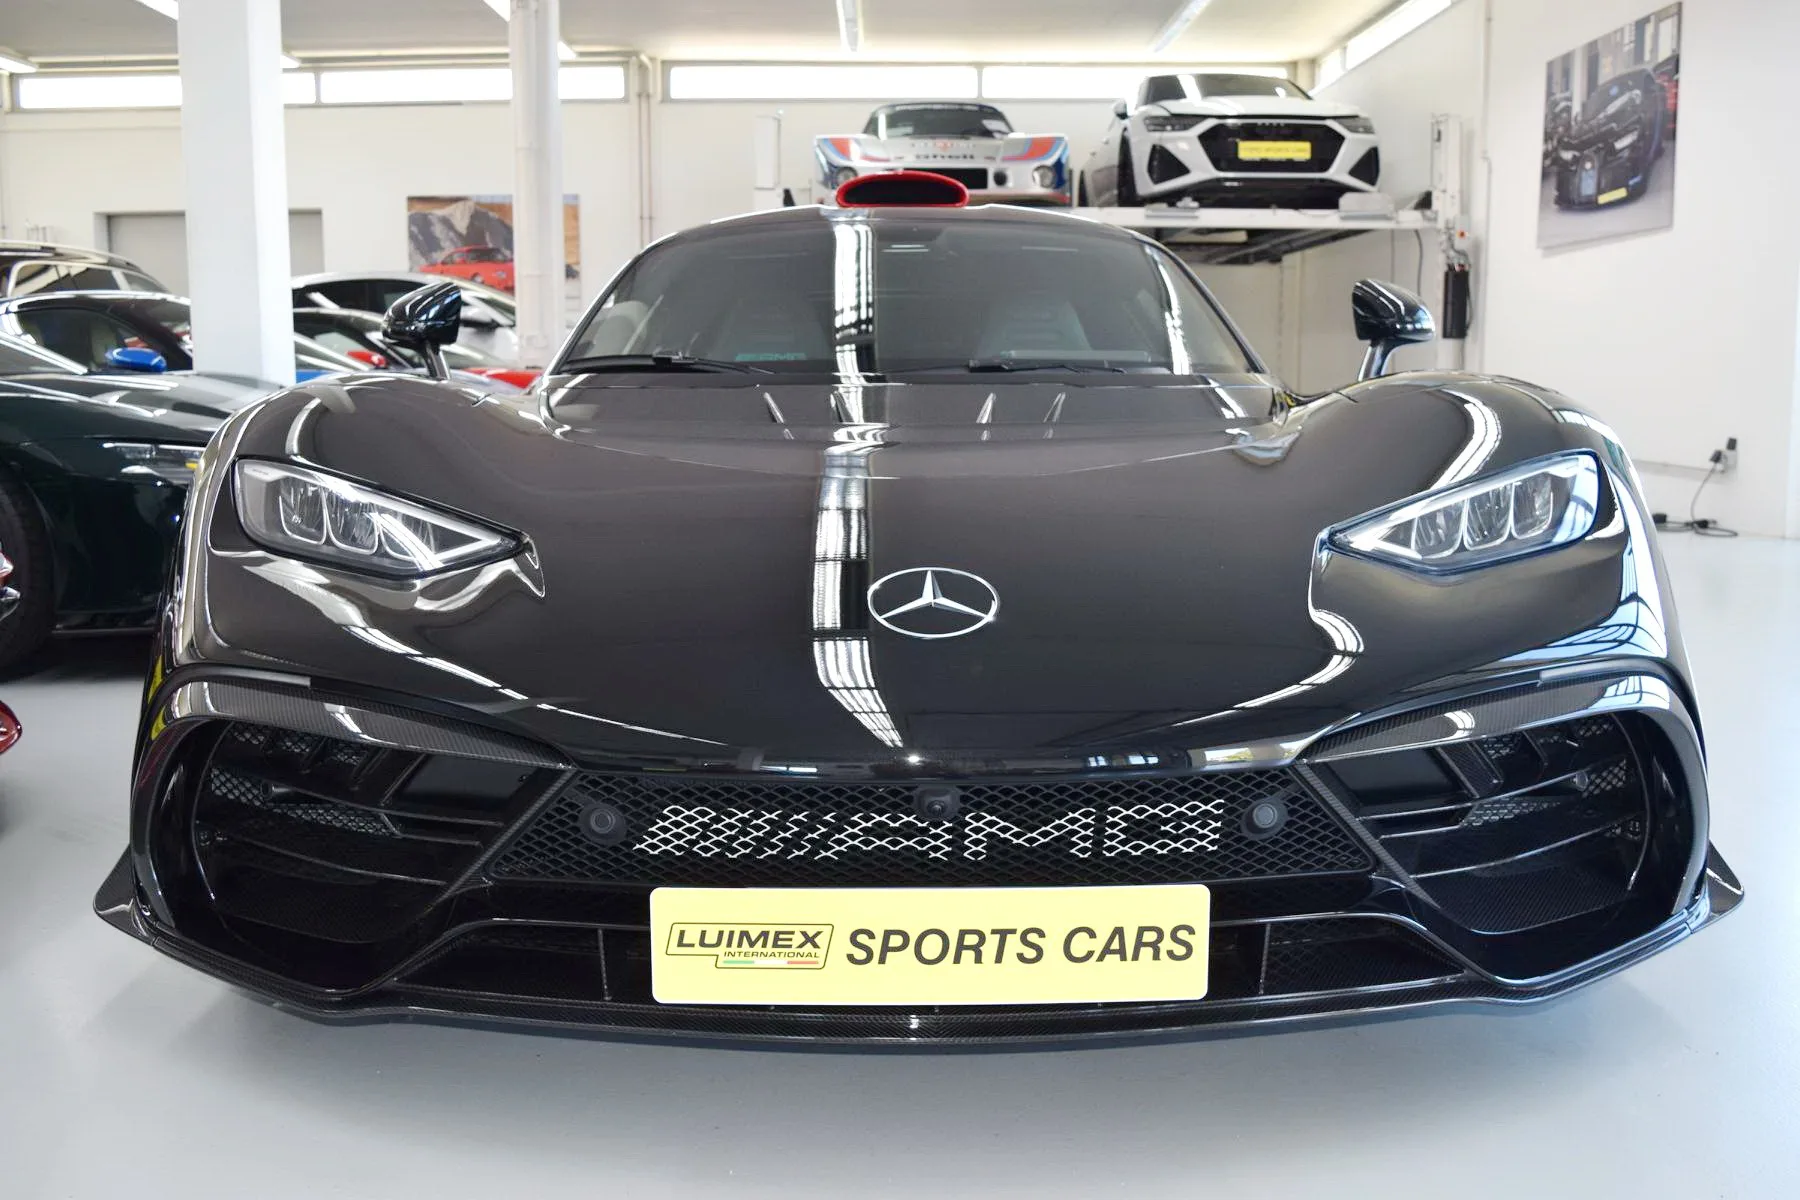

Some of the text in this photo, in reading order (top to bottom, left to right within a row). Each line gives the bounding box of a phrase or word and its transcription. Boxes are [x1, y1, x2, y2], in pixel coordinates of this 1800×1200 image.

[677, 929, 824, 949] LUIMEX
[846, 924, 1196, 965] SPORTS CARS
